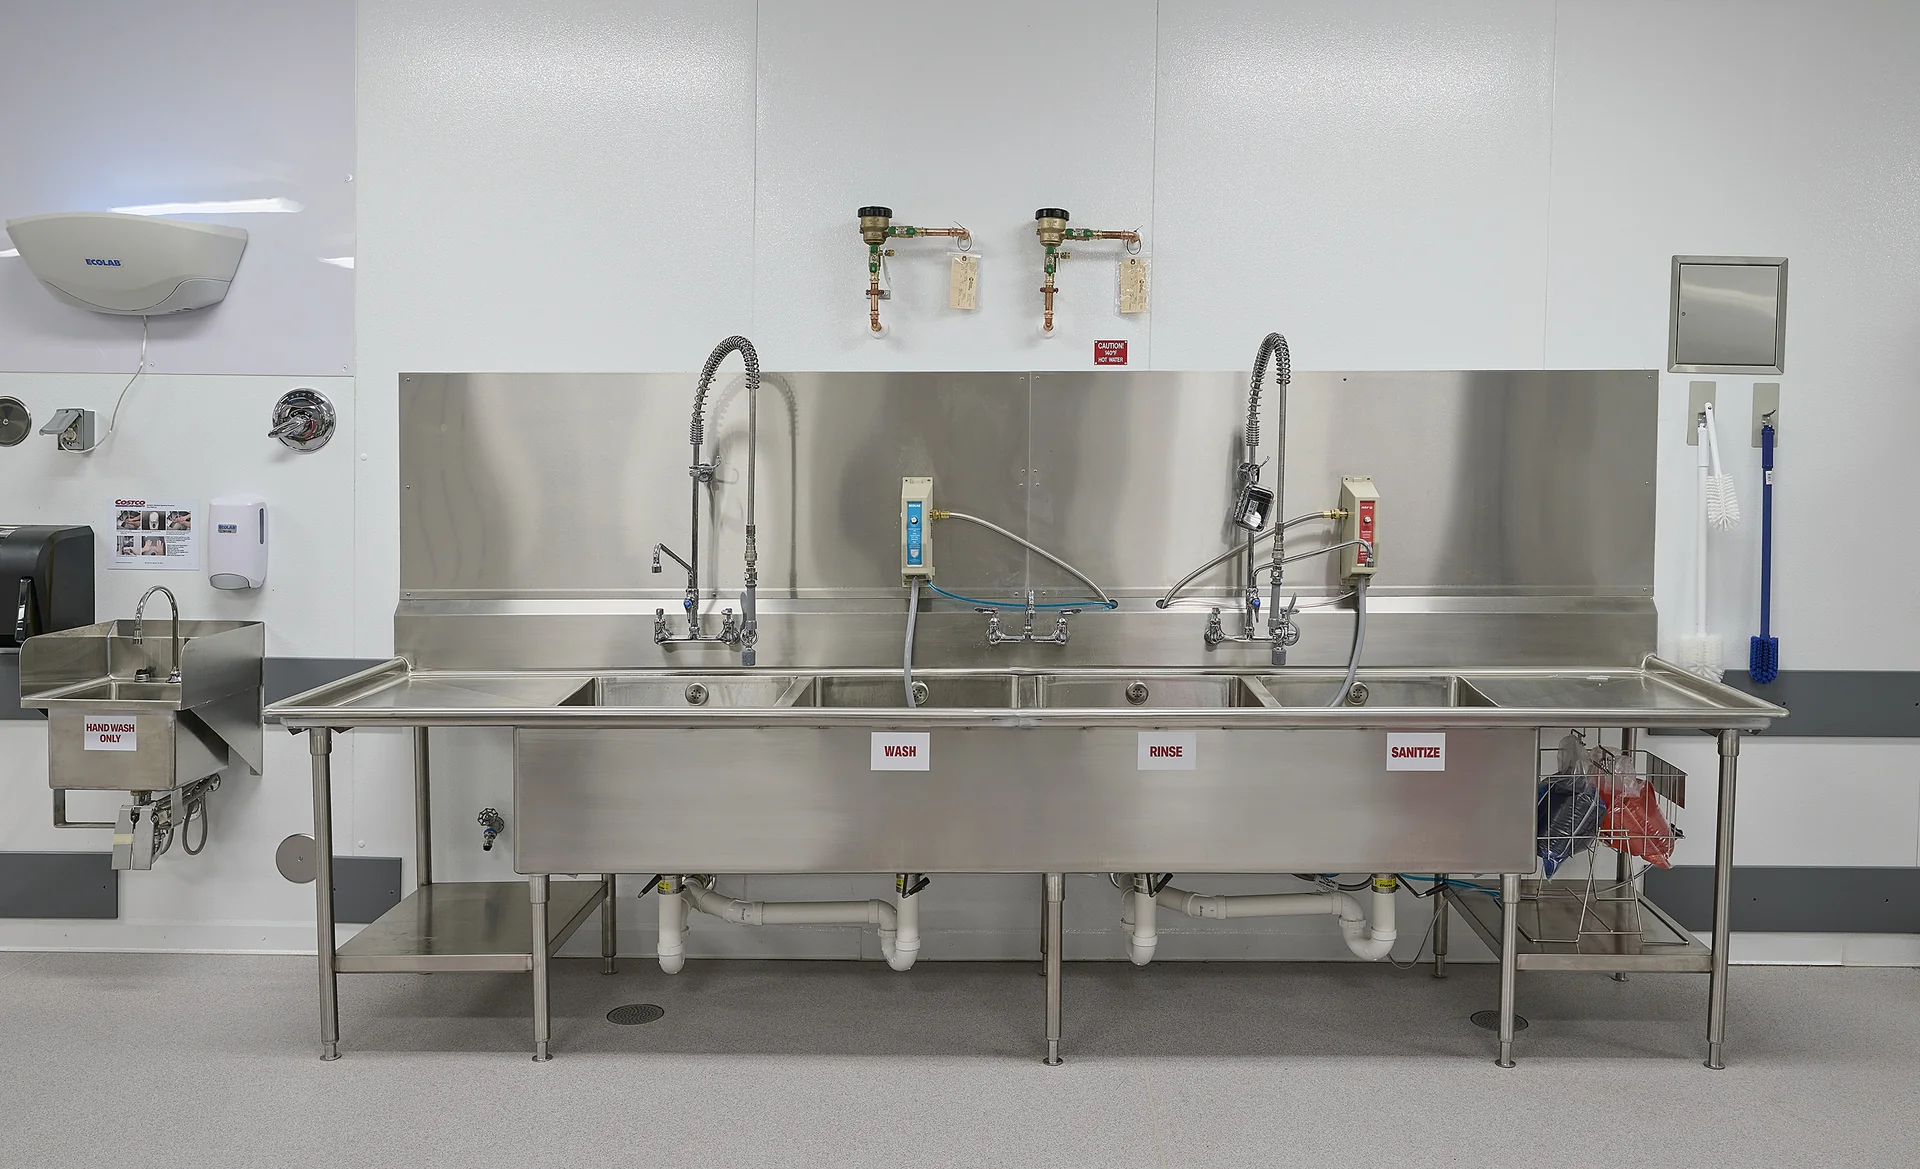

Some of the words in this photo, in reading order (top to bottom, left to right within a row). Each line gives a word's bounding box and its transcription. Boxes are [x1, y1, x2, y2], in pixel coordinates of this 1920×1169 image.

[85, 258, 122, 267] ECOLAB
[1097, 342, 1125, 350] CAUTION!
[86, 723, 110, 732] HAND
[110, 723, 135, 732] WASH
[100, 734, 122, 743] ONLY
[884, 745, 917, 757] WASH
[1149, 745, 1183, 758] RINSE
[1391, 746, 1440, 758] SANITIZE
